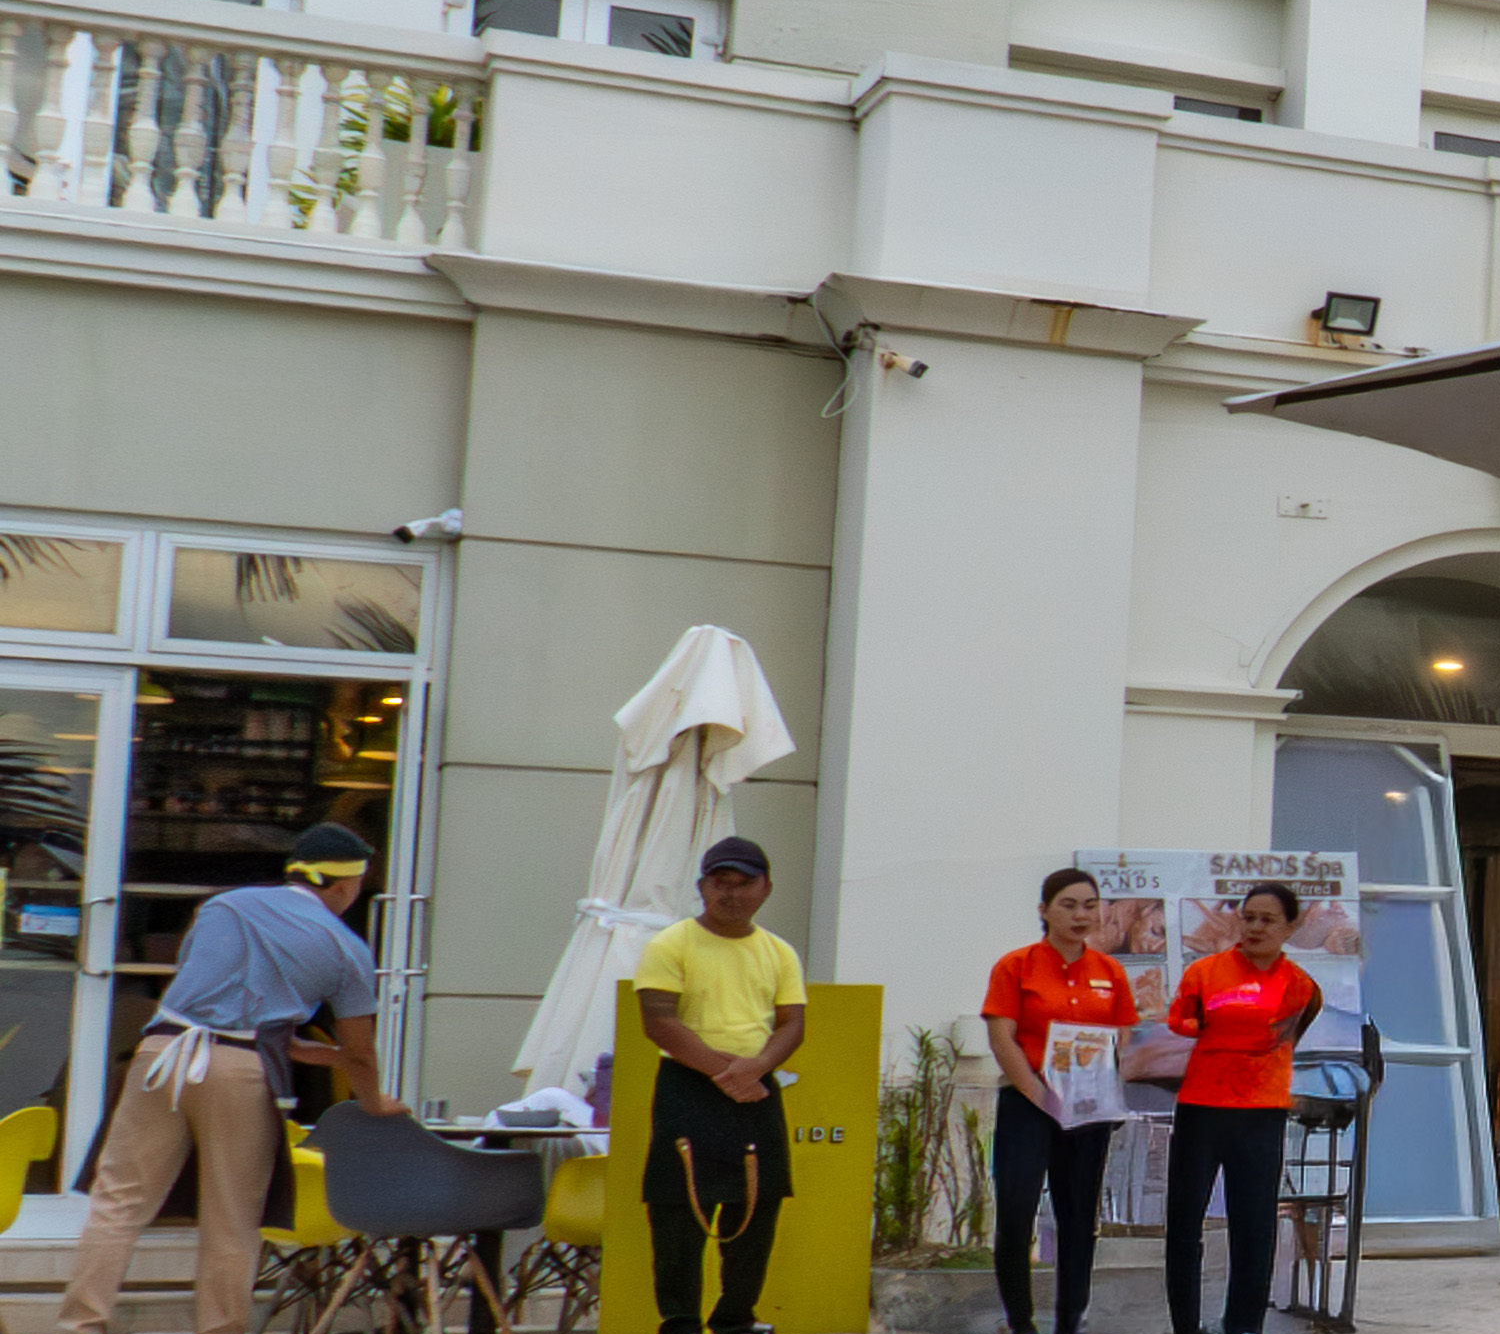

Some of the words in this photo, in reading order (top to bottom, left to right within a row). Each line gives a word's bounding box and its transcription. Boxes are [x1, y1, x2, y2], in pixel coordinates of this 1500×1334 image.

[1209, 853, 1298, 877] SANDS
[1303, 853, 1344, 880] Spa
[1101, 876, 1160, 889] ANDS
[797, 1126, 845, 1142] IDE
